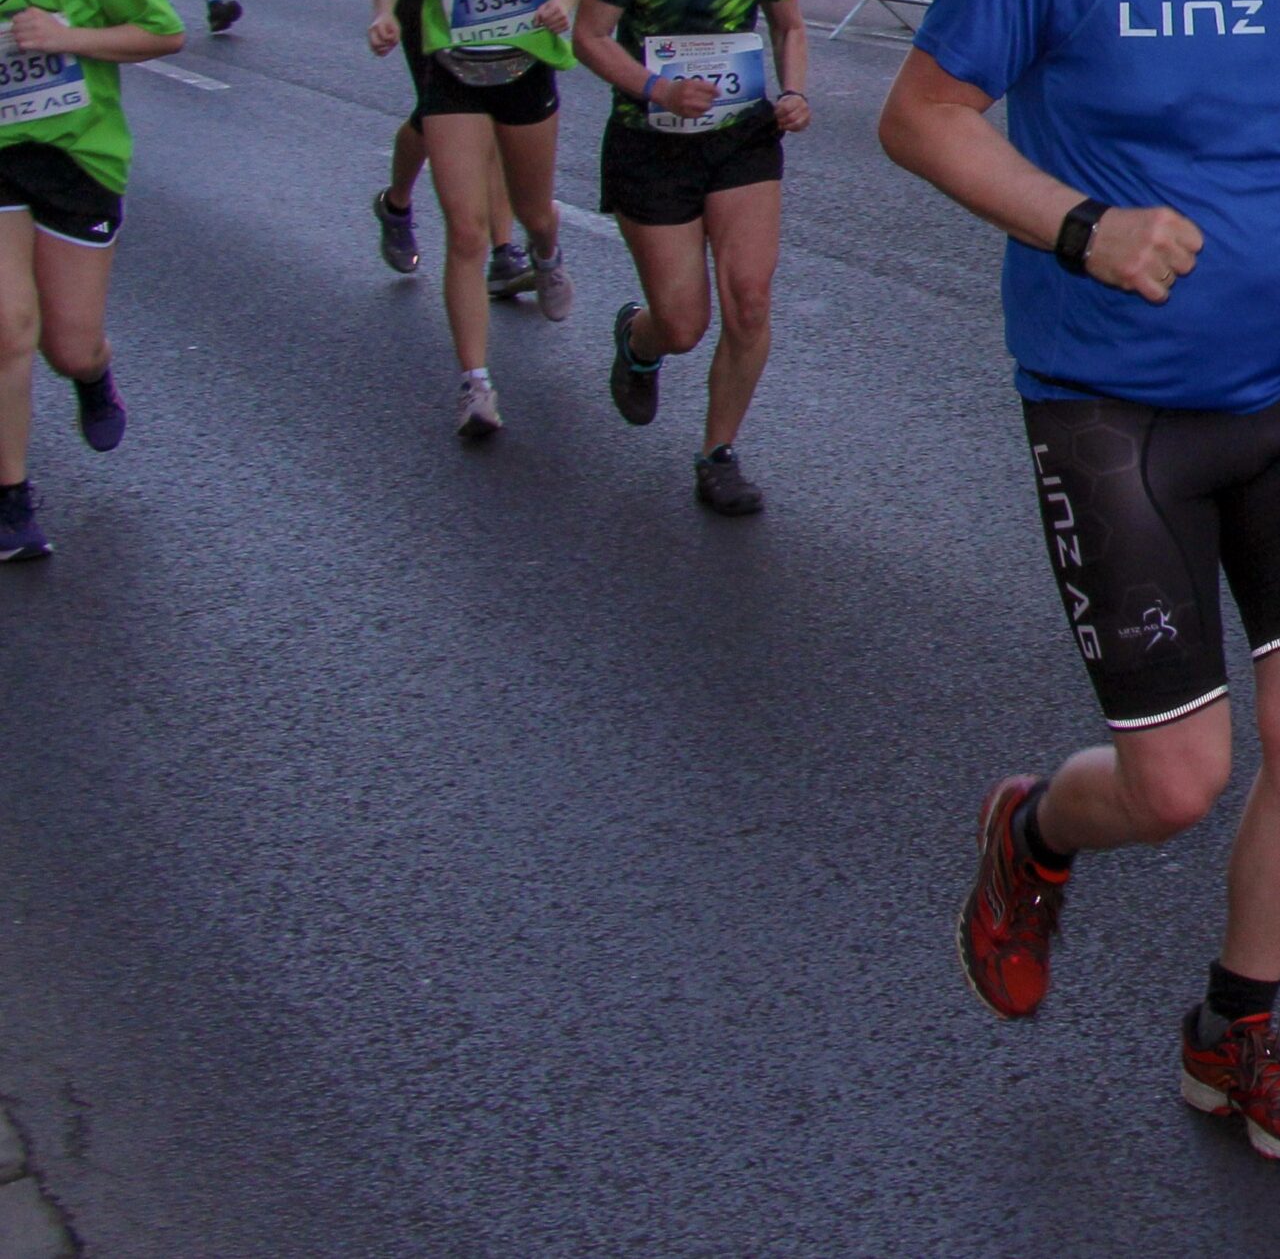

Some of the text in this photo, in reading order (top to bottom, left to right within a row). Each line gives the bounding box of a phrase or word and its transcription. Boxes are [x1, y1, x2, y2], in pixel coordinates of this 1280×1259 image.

[1119, 0, 1266, 37] LINZ
[43, 91, 82, 111] AG
[1034, 444, 1103, 660] LINZ AG
